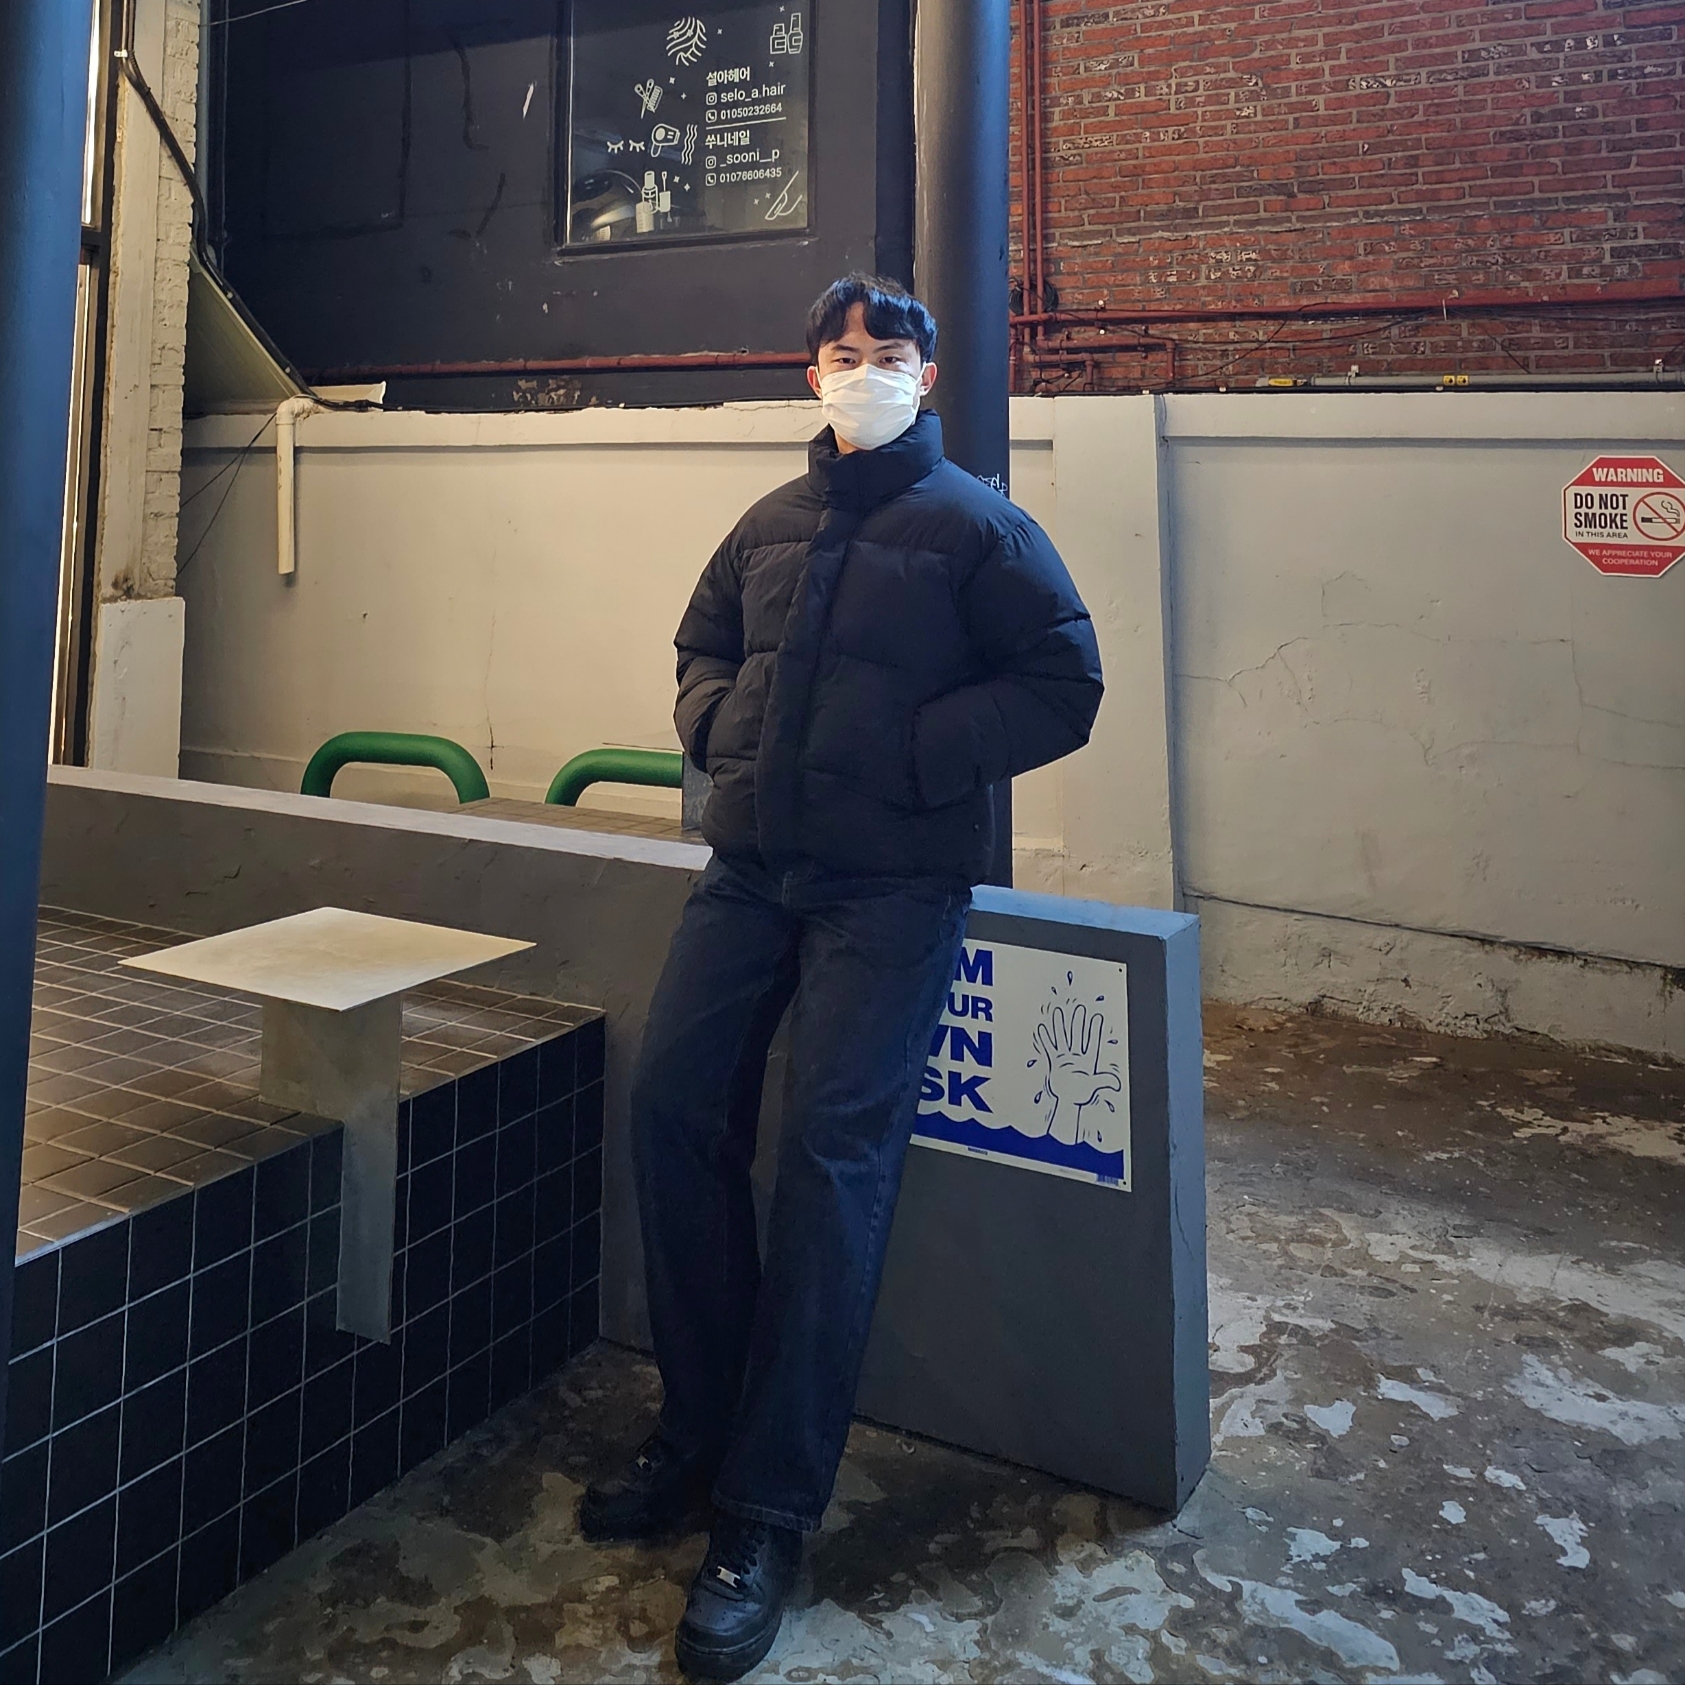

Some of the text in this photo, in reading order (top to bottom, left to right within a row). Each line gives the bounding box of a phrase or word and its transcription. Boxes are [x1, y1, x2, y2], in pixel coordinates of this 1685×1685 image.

[706, 66, 750, 87] 설아헤어
[720, 82, 786, 103] selo_a.hair
[720, 102, 782, 120] 01050232664
[705, 129, 750, 149] 쑤니네일
[1592, 467, 1664, 483] WARNING
[1574, 492, 1629, 511] DO NOT
[1574, 512, 1628, 530] SMOKE
[1606, 531, 1628, 539] AREA
[1588, 548, 1601, 556] WE
[1602, 549, 1648, 558] APPRECIATE
[1602, 557, 1659, 566] COOPERATION
